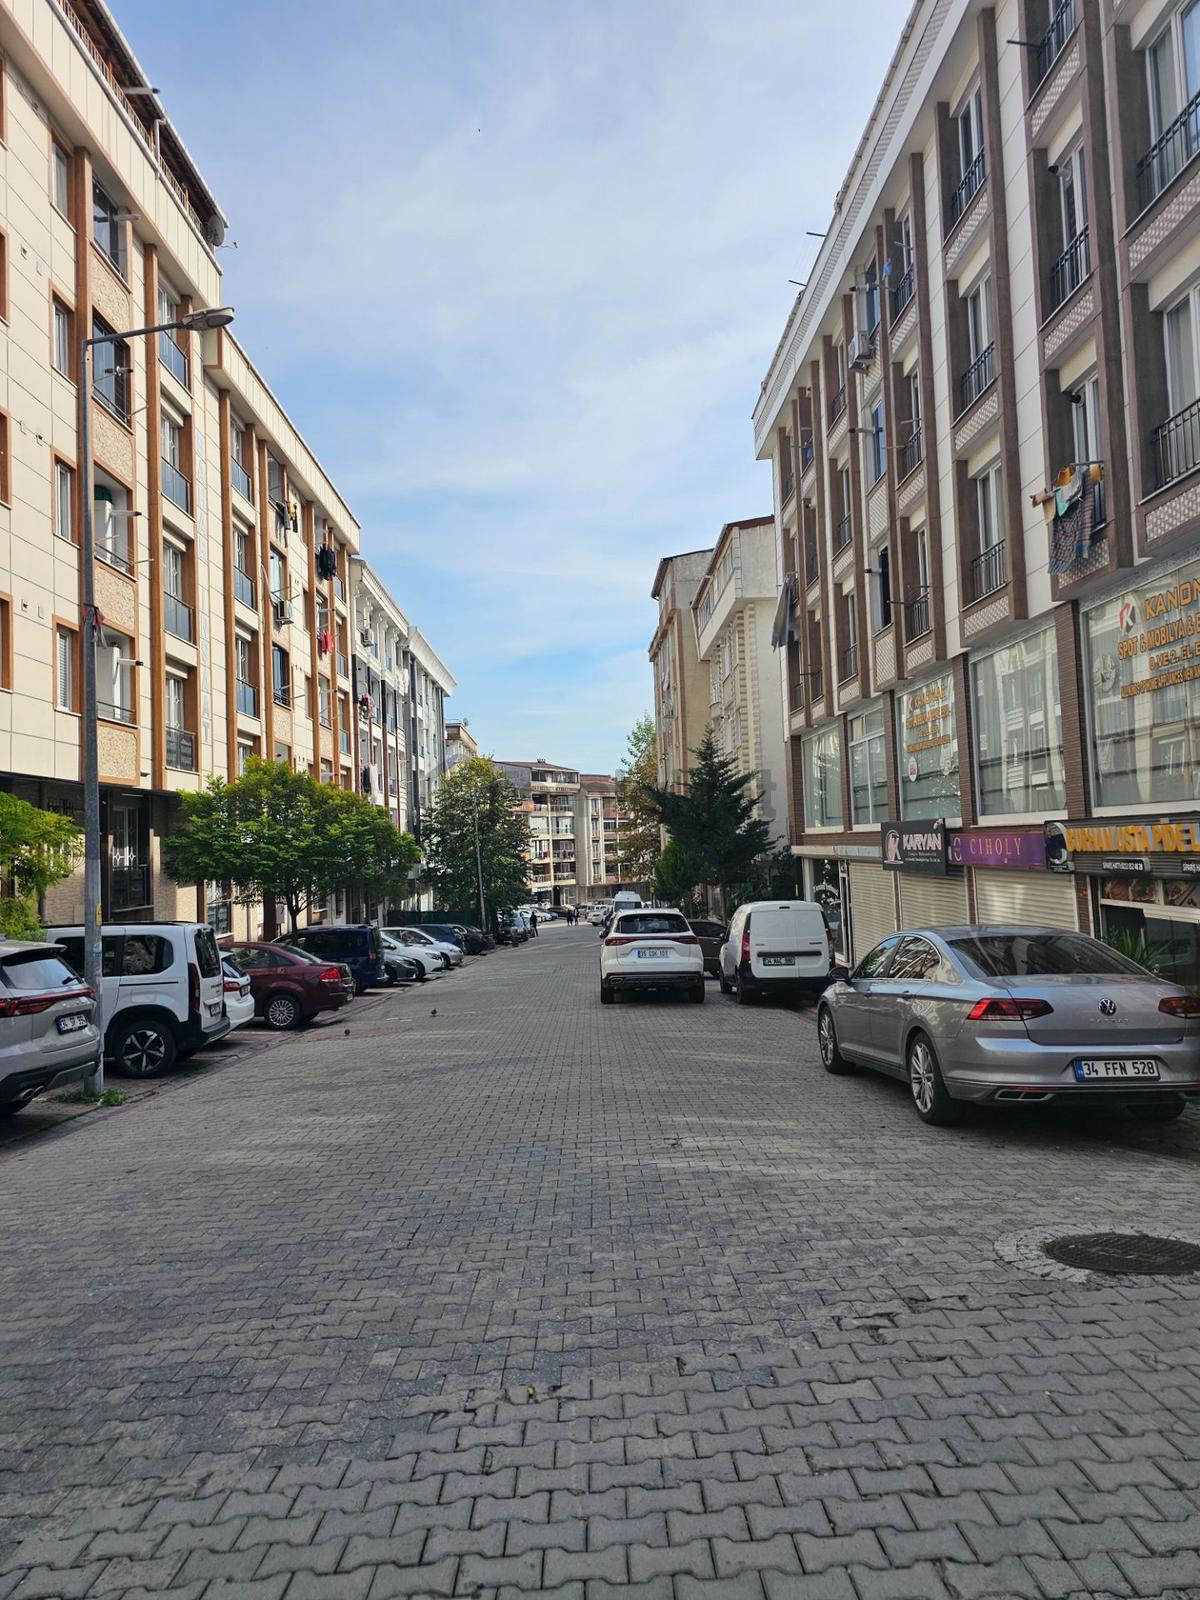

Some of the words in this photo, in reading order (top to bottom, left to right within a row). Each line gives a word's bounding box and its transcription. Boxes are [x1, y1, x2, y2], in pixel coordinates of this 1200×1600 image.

[1118, 636, 1138, 661] SPOT
[902, 833, 941, 850] KARYAN
[969, 837, 1022, 856] CIHOLY
[1084, 1062, 1098, 1076] 34
[1104, 1062, 1127, 1076] FFN
[1132, 1061, 1155, 1075] 528
